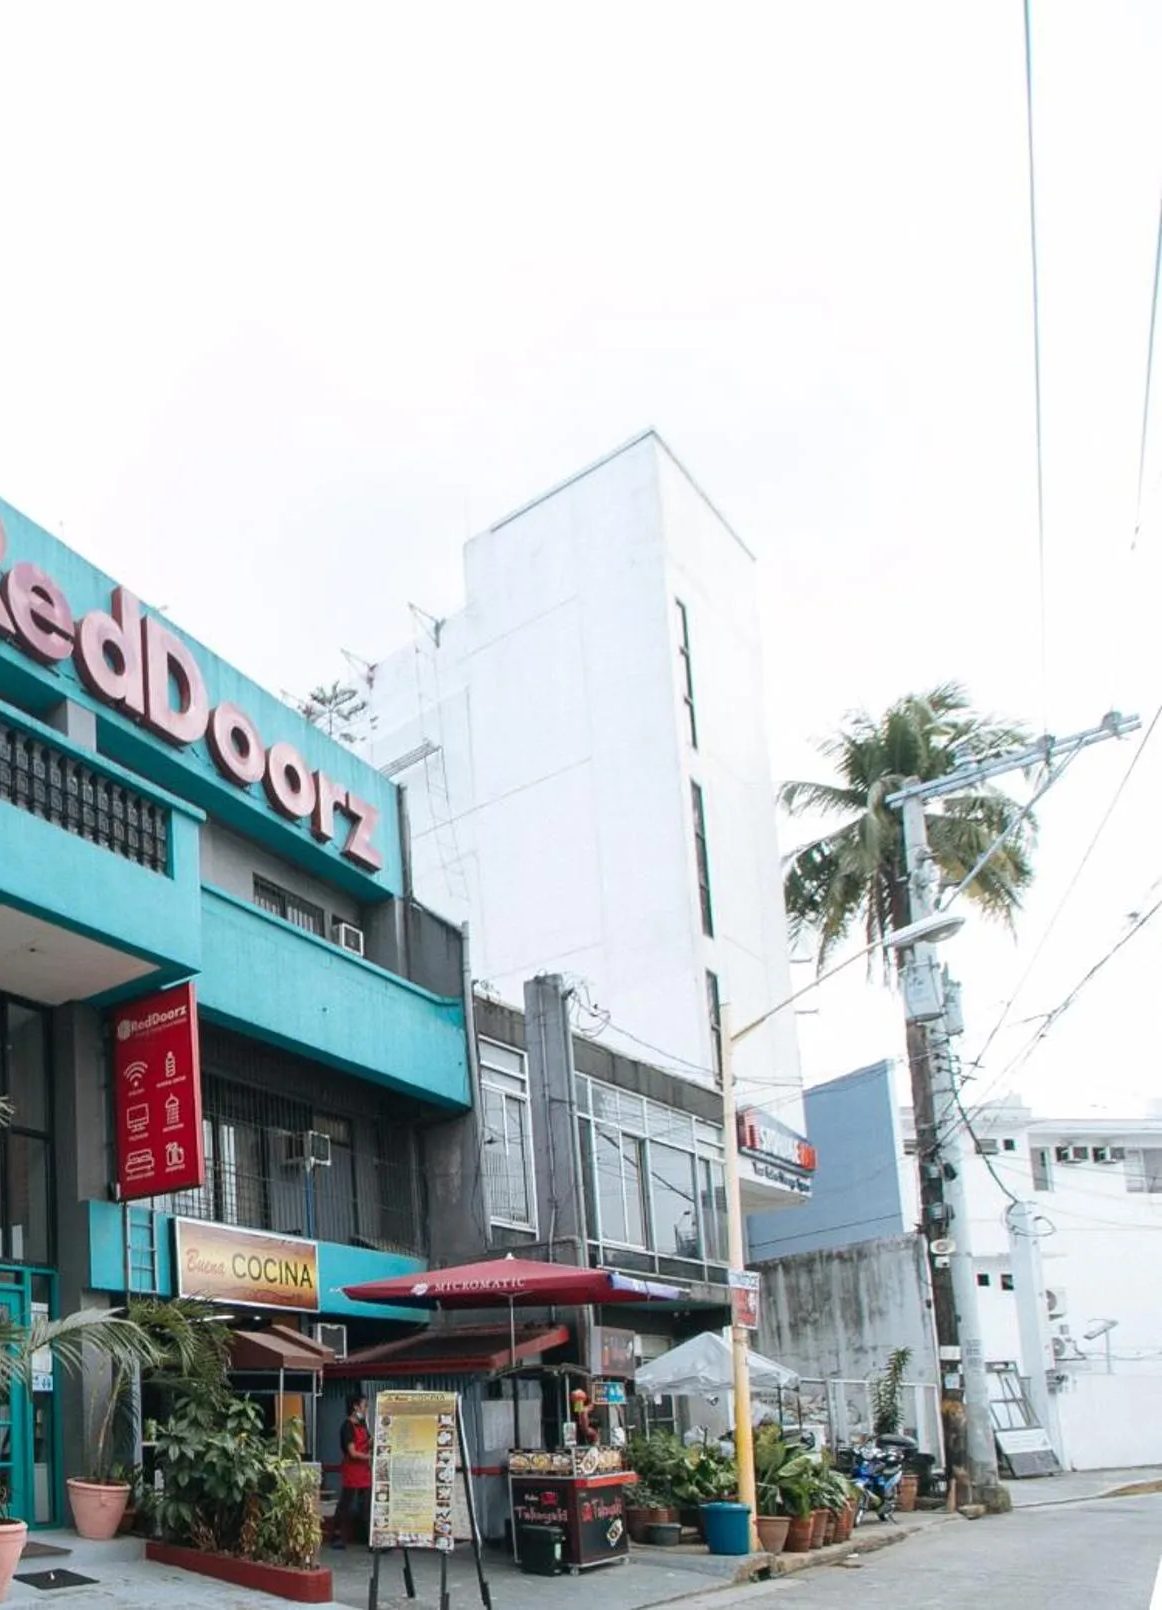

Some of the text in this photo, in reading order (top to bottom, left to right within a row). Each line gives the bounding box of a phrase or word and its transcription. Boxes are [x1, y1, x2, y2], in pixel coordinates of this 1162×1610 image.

[131, 1005, 187, 1033] RedDoorz
[187, 1248, 313, 1289] Buena COCINA
[435, 1277, 526, 1293] MICROMATIC
